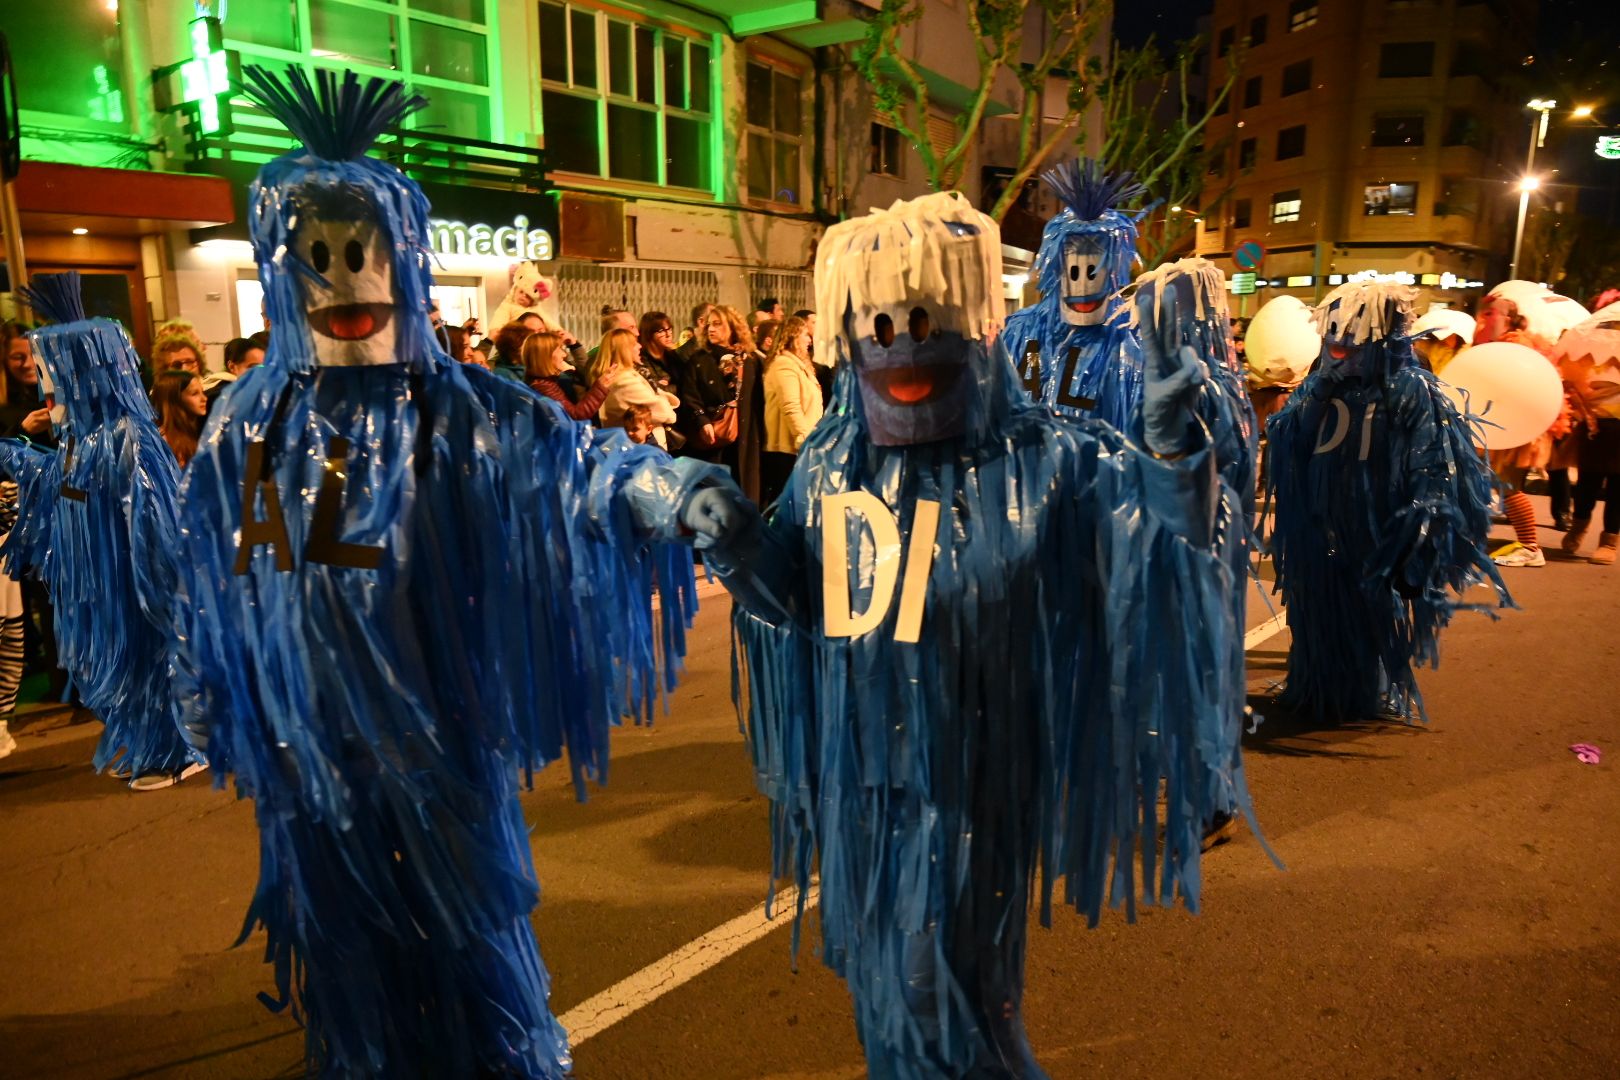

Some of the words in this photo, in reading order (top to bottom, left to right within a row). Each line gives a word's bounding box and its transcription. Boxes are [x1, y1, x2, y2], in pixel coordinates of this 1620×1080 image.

[1313, 397, 1377, 461] DI
[233, 436, 386, 577] AL
[821, 490, 941, 644] DI
